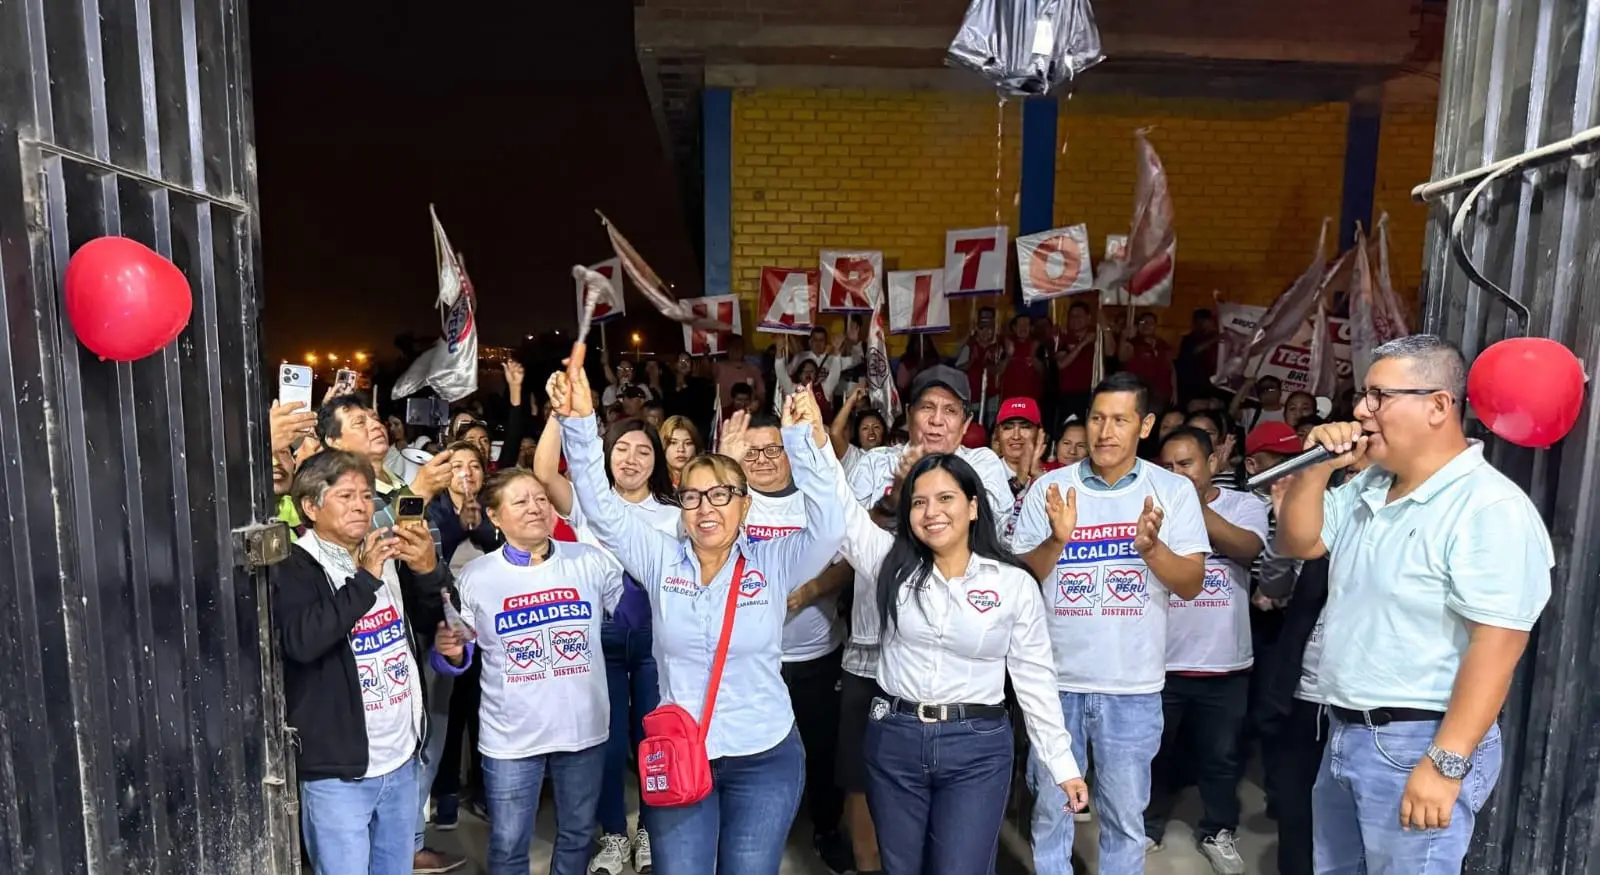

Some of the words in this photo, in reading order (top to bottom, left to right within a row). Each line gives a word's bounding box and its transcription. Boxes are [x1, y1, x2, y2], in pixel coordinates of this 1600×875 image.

[954, 238, 995, 290] T
[1029, 235, 1081, 293] O
[829, 257, 873, 307] R
[764, 272, 811, 325] A
[912, 275, 932, 326] I
[691, 301, 733, 354] H
[1279, 350, 1312, 366] TEC
[1071, 525, 1137, 540] CHARITO
[1059, 542, 1139, 560] ALCALDES
[508, 590, 575, 609] CHARITO
[1194, 600, 1230, 608] DISTRITAL
[498, 603, 591, 631] ALCALDESA
[1055, 609, 1094, 617] PROVINCIAL
[1102, 609, 1144, 617] DISTRITAL
[507, 673, 546, 683] PROVINCIAL
[553, 666, 590, 677] DISTRITAL
